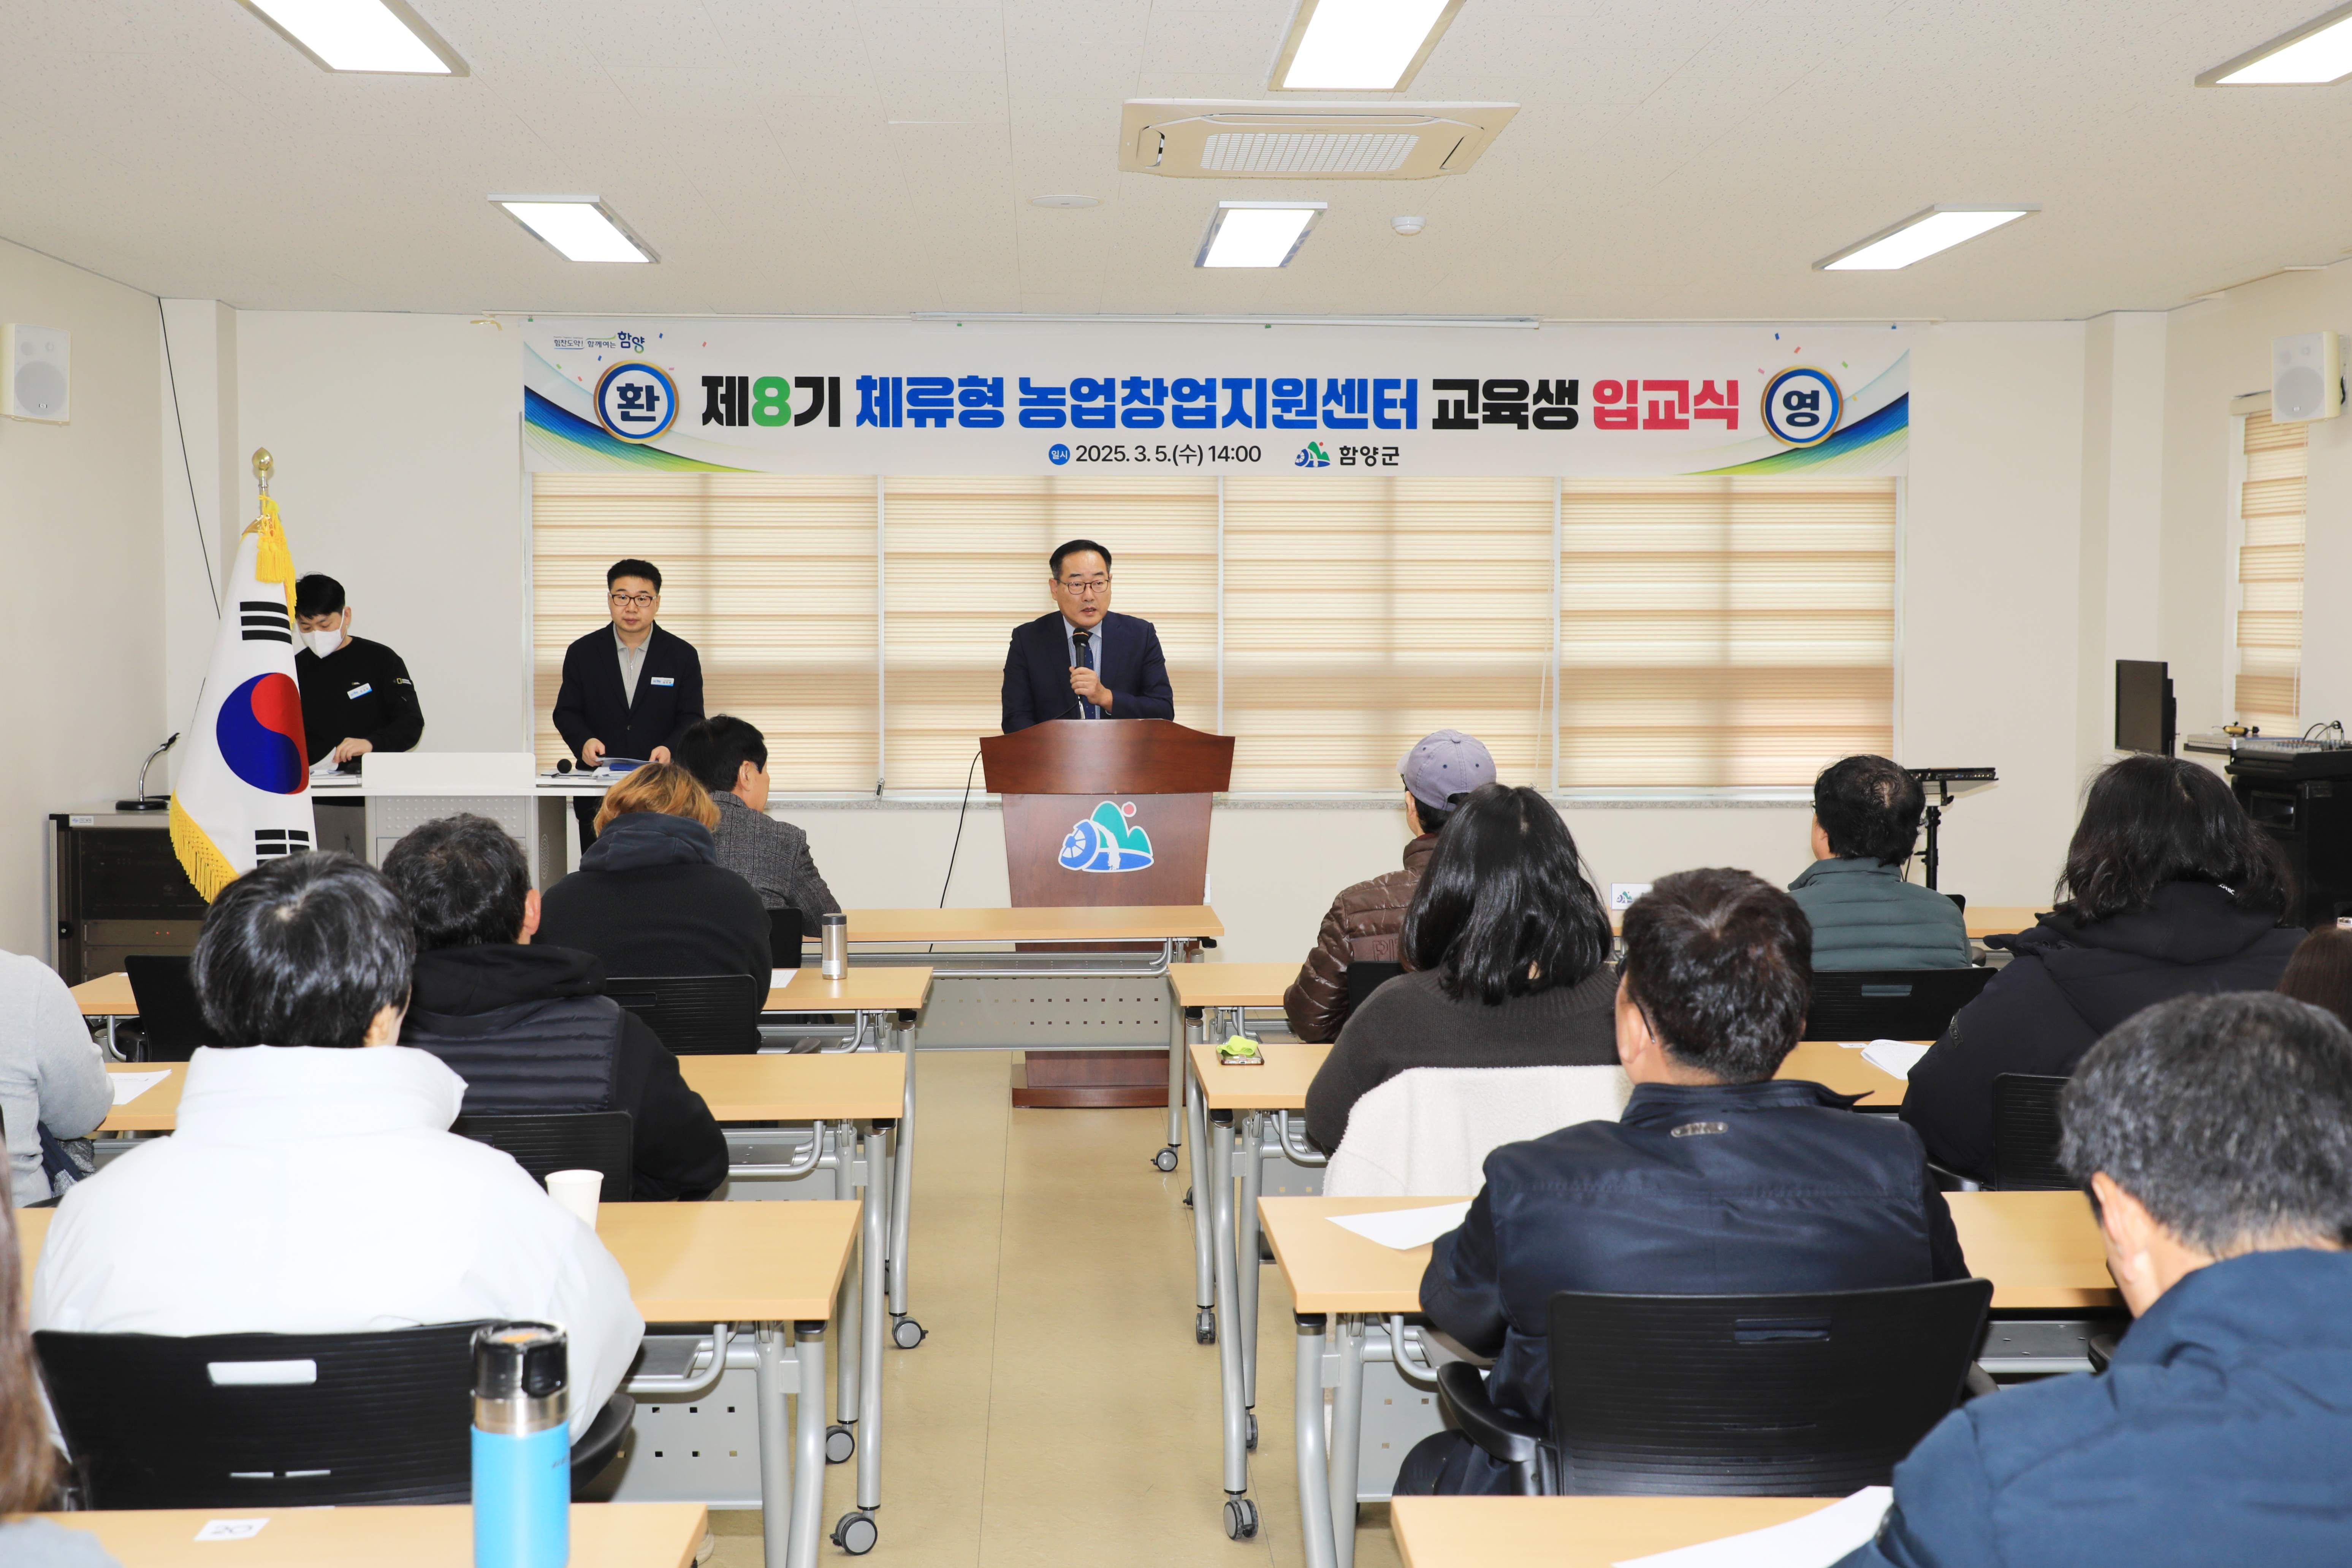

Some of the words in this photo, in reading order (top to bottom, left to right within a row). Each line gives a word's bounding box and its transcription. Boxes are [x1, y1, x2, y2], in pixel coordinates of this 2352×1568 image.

[618, 331, 645, 354] 함양
[616, 383, 660, 422] 환
[702, 376, 840, 427] 제8기
[856, 375, 1004, 428] 체류형
[1019, 376, 1418, 429] 농업창업지원센터
[1432, 379, 1579, 430] 교육생
[1593, 380, 1739, 429] 입교식
[1783, 390, 1820, 427] 영
[1052, 450, 1068, 459] 일시
[1076, 445, 1130, 462] 2025.
[1134, 445, 1151, 462] 3.
[1208, 445, 1261, 462] 14:00
[1339, 445, 1400, 467] 함양군
